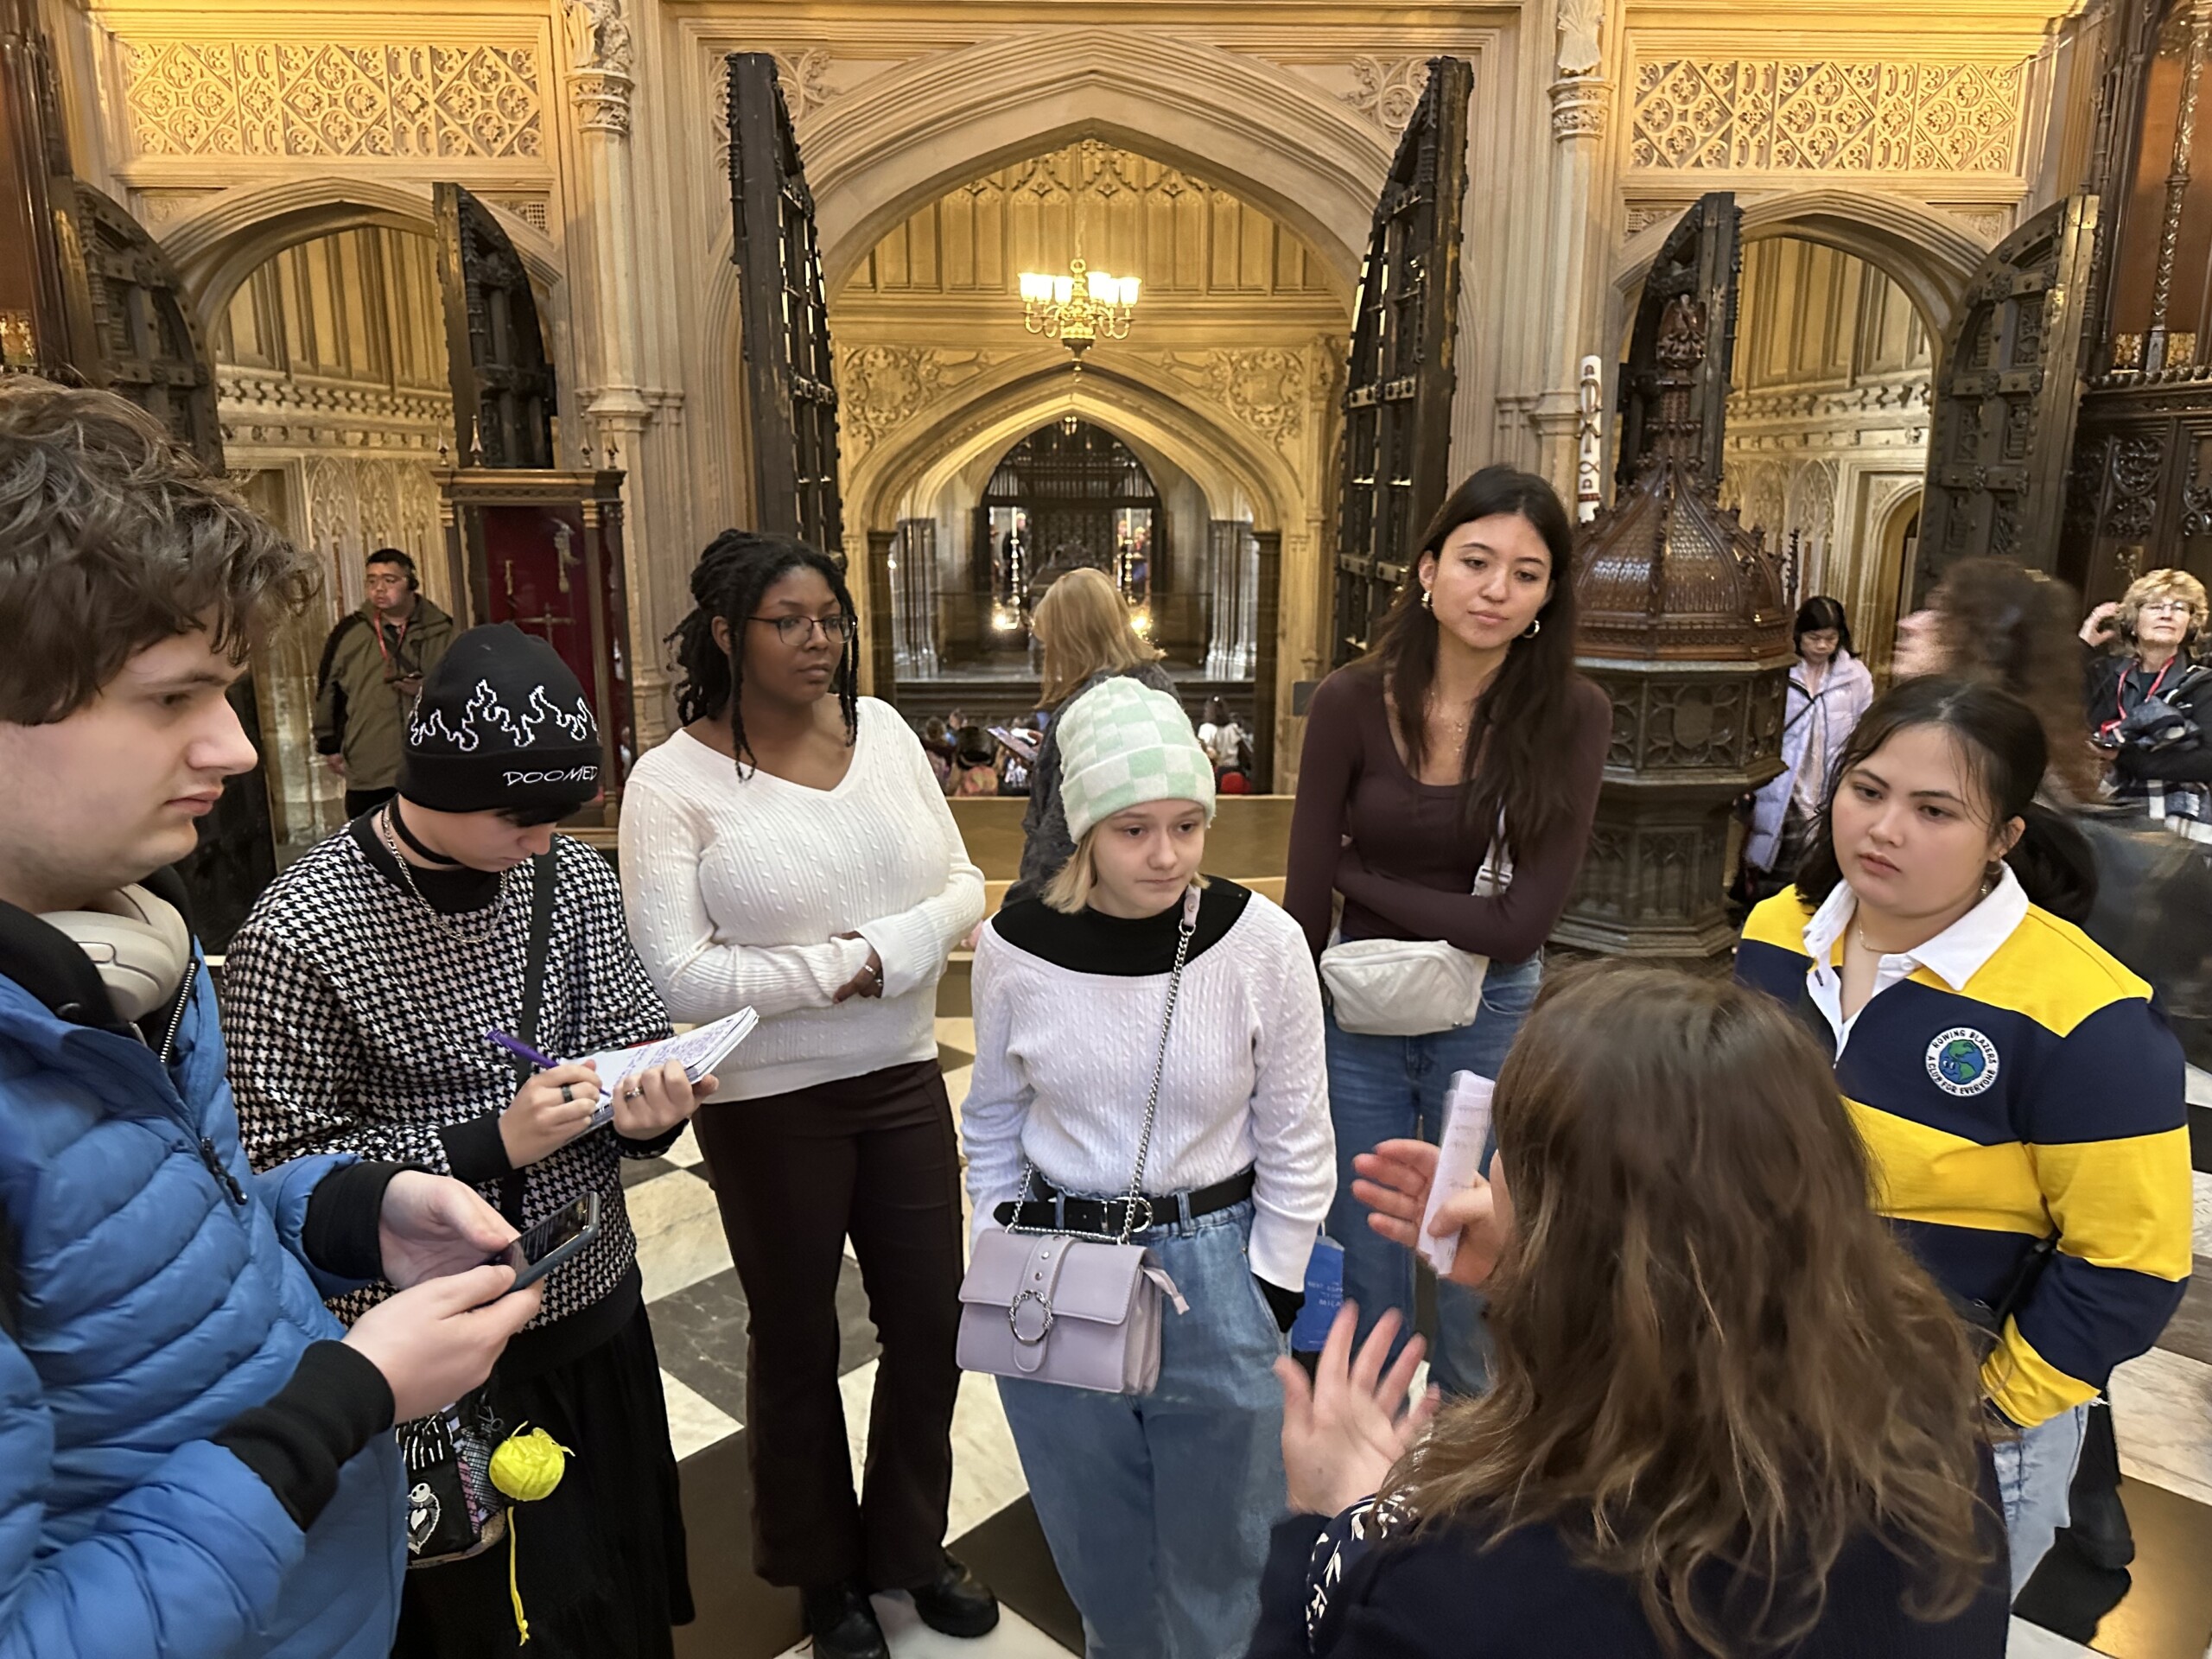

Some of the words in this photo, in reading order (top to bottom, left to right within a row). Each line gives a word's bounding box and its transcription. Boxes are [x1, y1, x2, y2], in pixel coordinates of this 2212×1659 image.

[502, 765, 598, 786] DOOMED
[1968, 1031, 1997, 1064] BLAZERS
[1928, 1063, 1942, 1082] CLUB
[1941, 1081, 1956, 1093] FOR
[1960, 1070, 1996, 1095] EVERYONE
